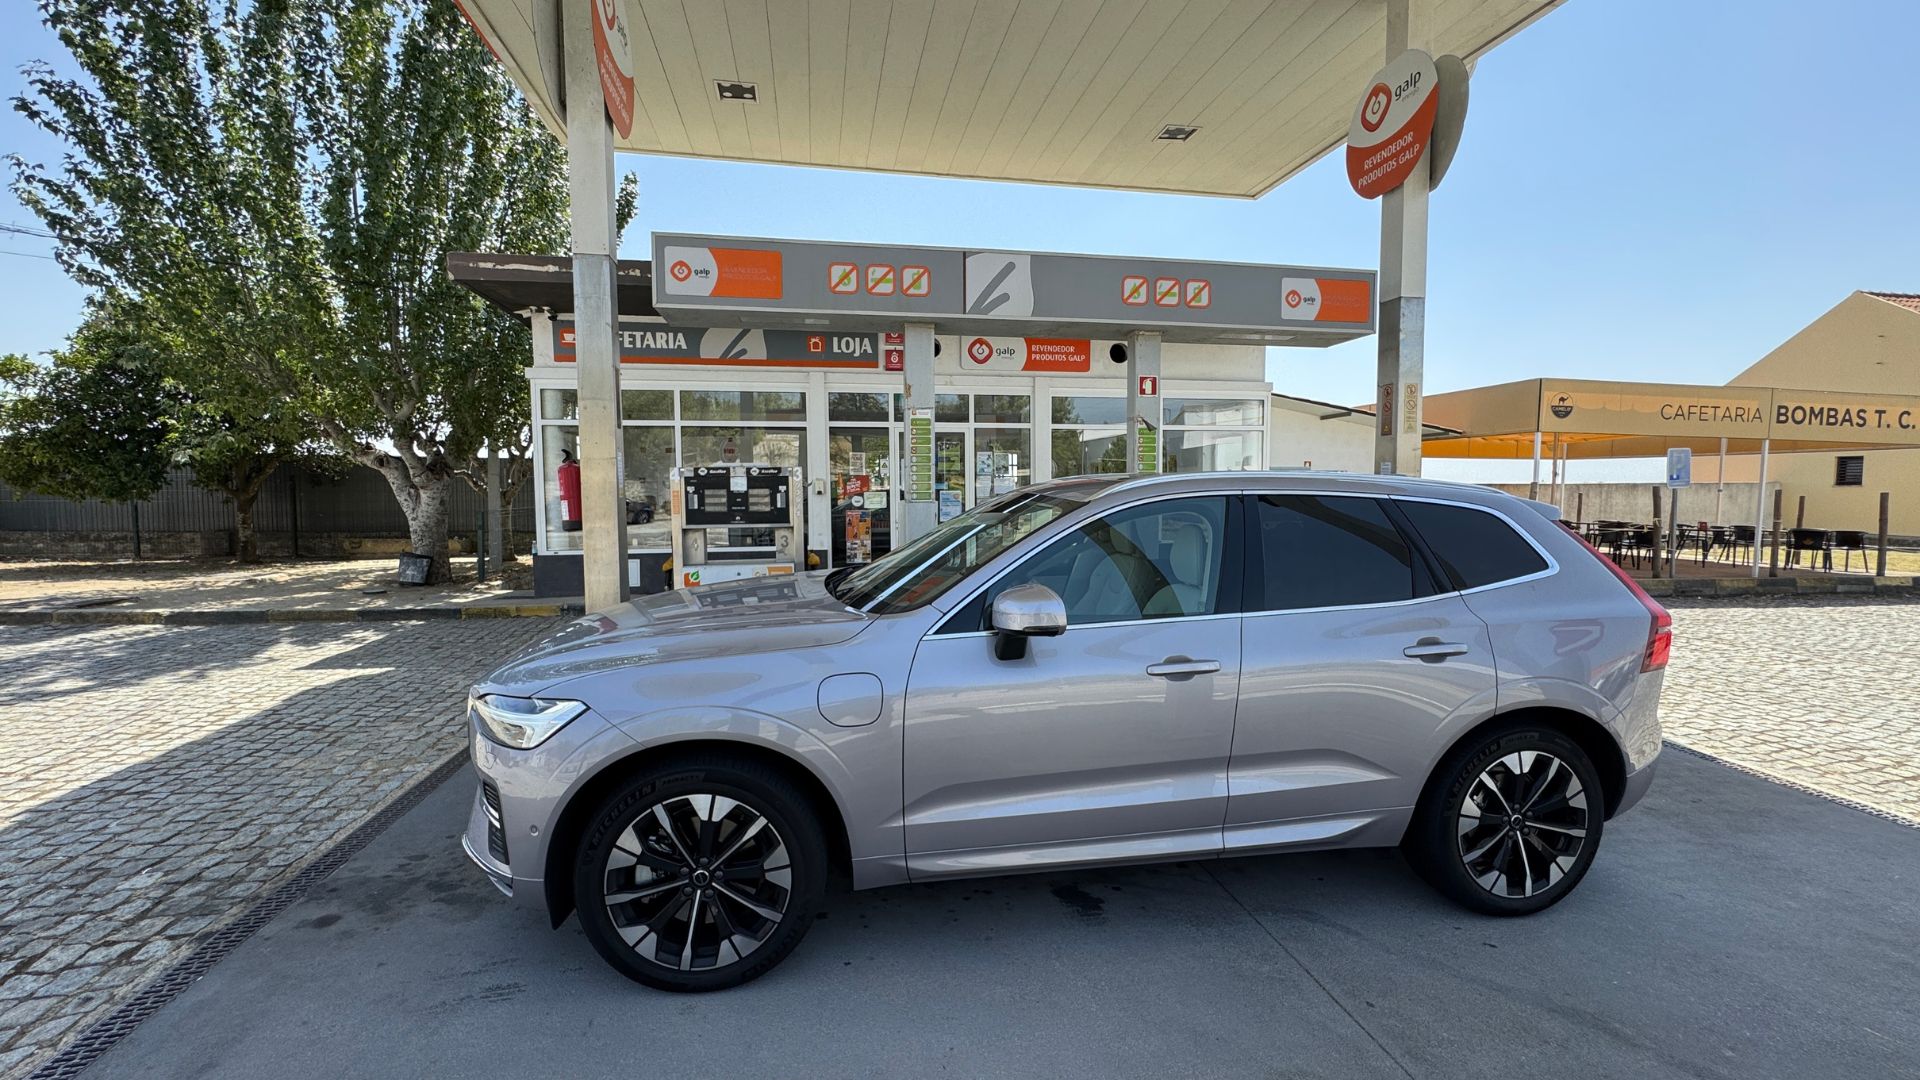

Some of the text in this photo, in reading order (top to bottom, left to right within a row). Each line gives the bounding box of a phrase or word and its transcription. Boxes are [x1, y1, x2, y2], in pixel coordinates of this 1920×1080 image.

[1394, 71, 1422, 102] galp
[1364, 132, 1413, 170] REVENDEDOR
[1357, 143, 1421, 189] PRODUTOS GALP
[693, 268, 711, 276] galp
[619, 331, 688, 350] FETARIA
[832, 336, 873, 357] LOJA
[1031, 344, 1075, 353] REVENDEDOR
[995, 346, 1015, 357] galp
[1031, 353, 1086, 362] PRODUTOS GALP
[1660, 403, 1917, 430] CAFETARIA BOMBAS T. C.
[793, 467, 802, 481] 3
[780, 535, 789, 549] 3
[1453, 742, 1499, 794] MICHELIN
[591, 782, 653, 846] MICHELIN
